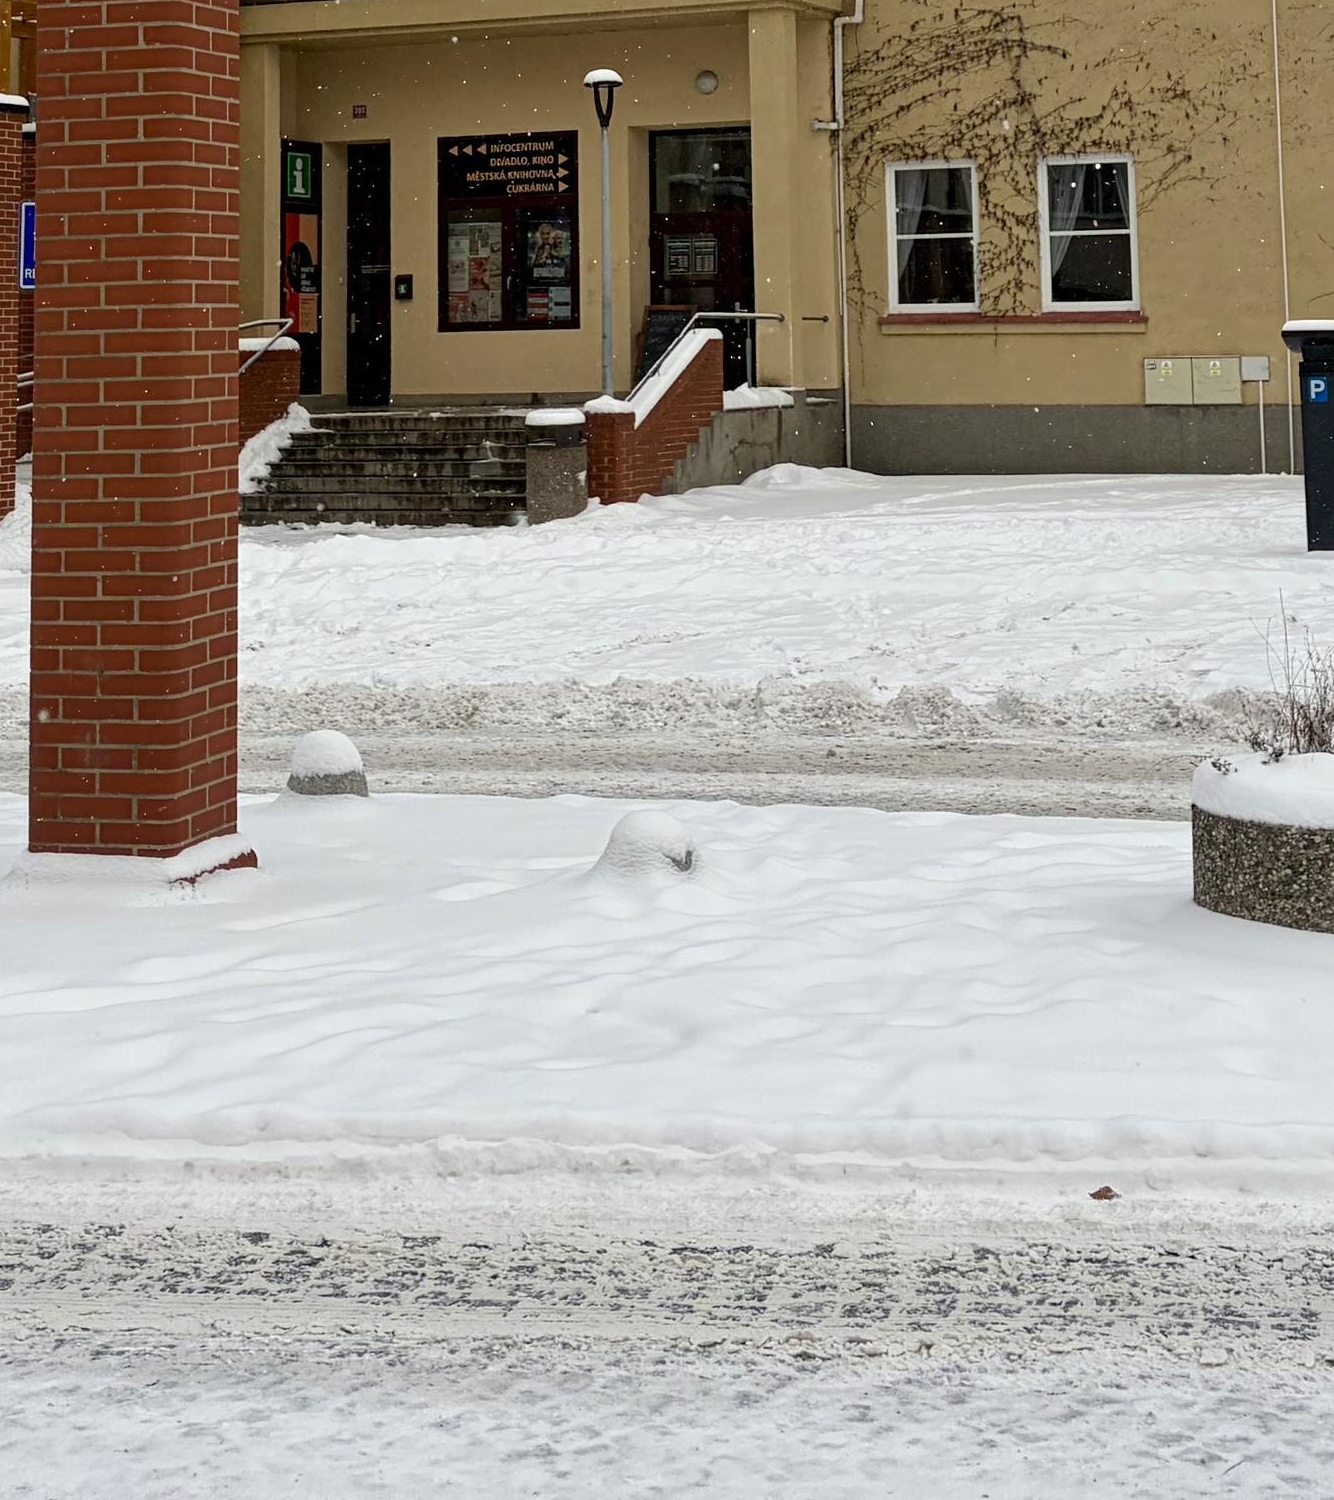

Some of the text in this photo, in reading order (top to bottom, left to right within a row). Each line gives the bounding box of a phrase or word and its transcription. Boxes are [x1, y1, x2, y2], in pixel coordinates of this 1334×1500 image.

[490, 141, 554, 153] INFOCENTRUM
[490, 155, 554, 167] DIVADLO, KINO
[467, 169, 555, 181] MĚSTSKÁ KNIHOVNA
[507, 181, 554, 193] CUKRÁRNA
[1310, 379, 1325, 399] P
